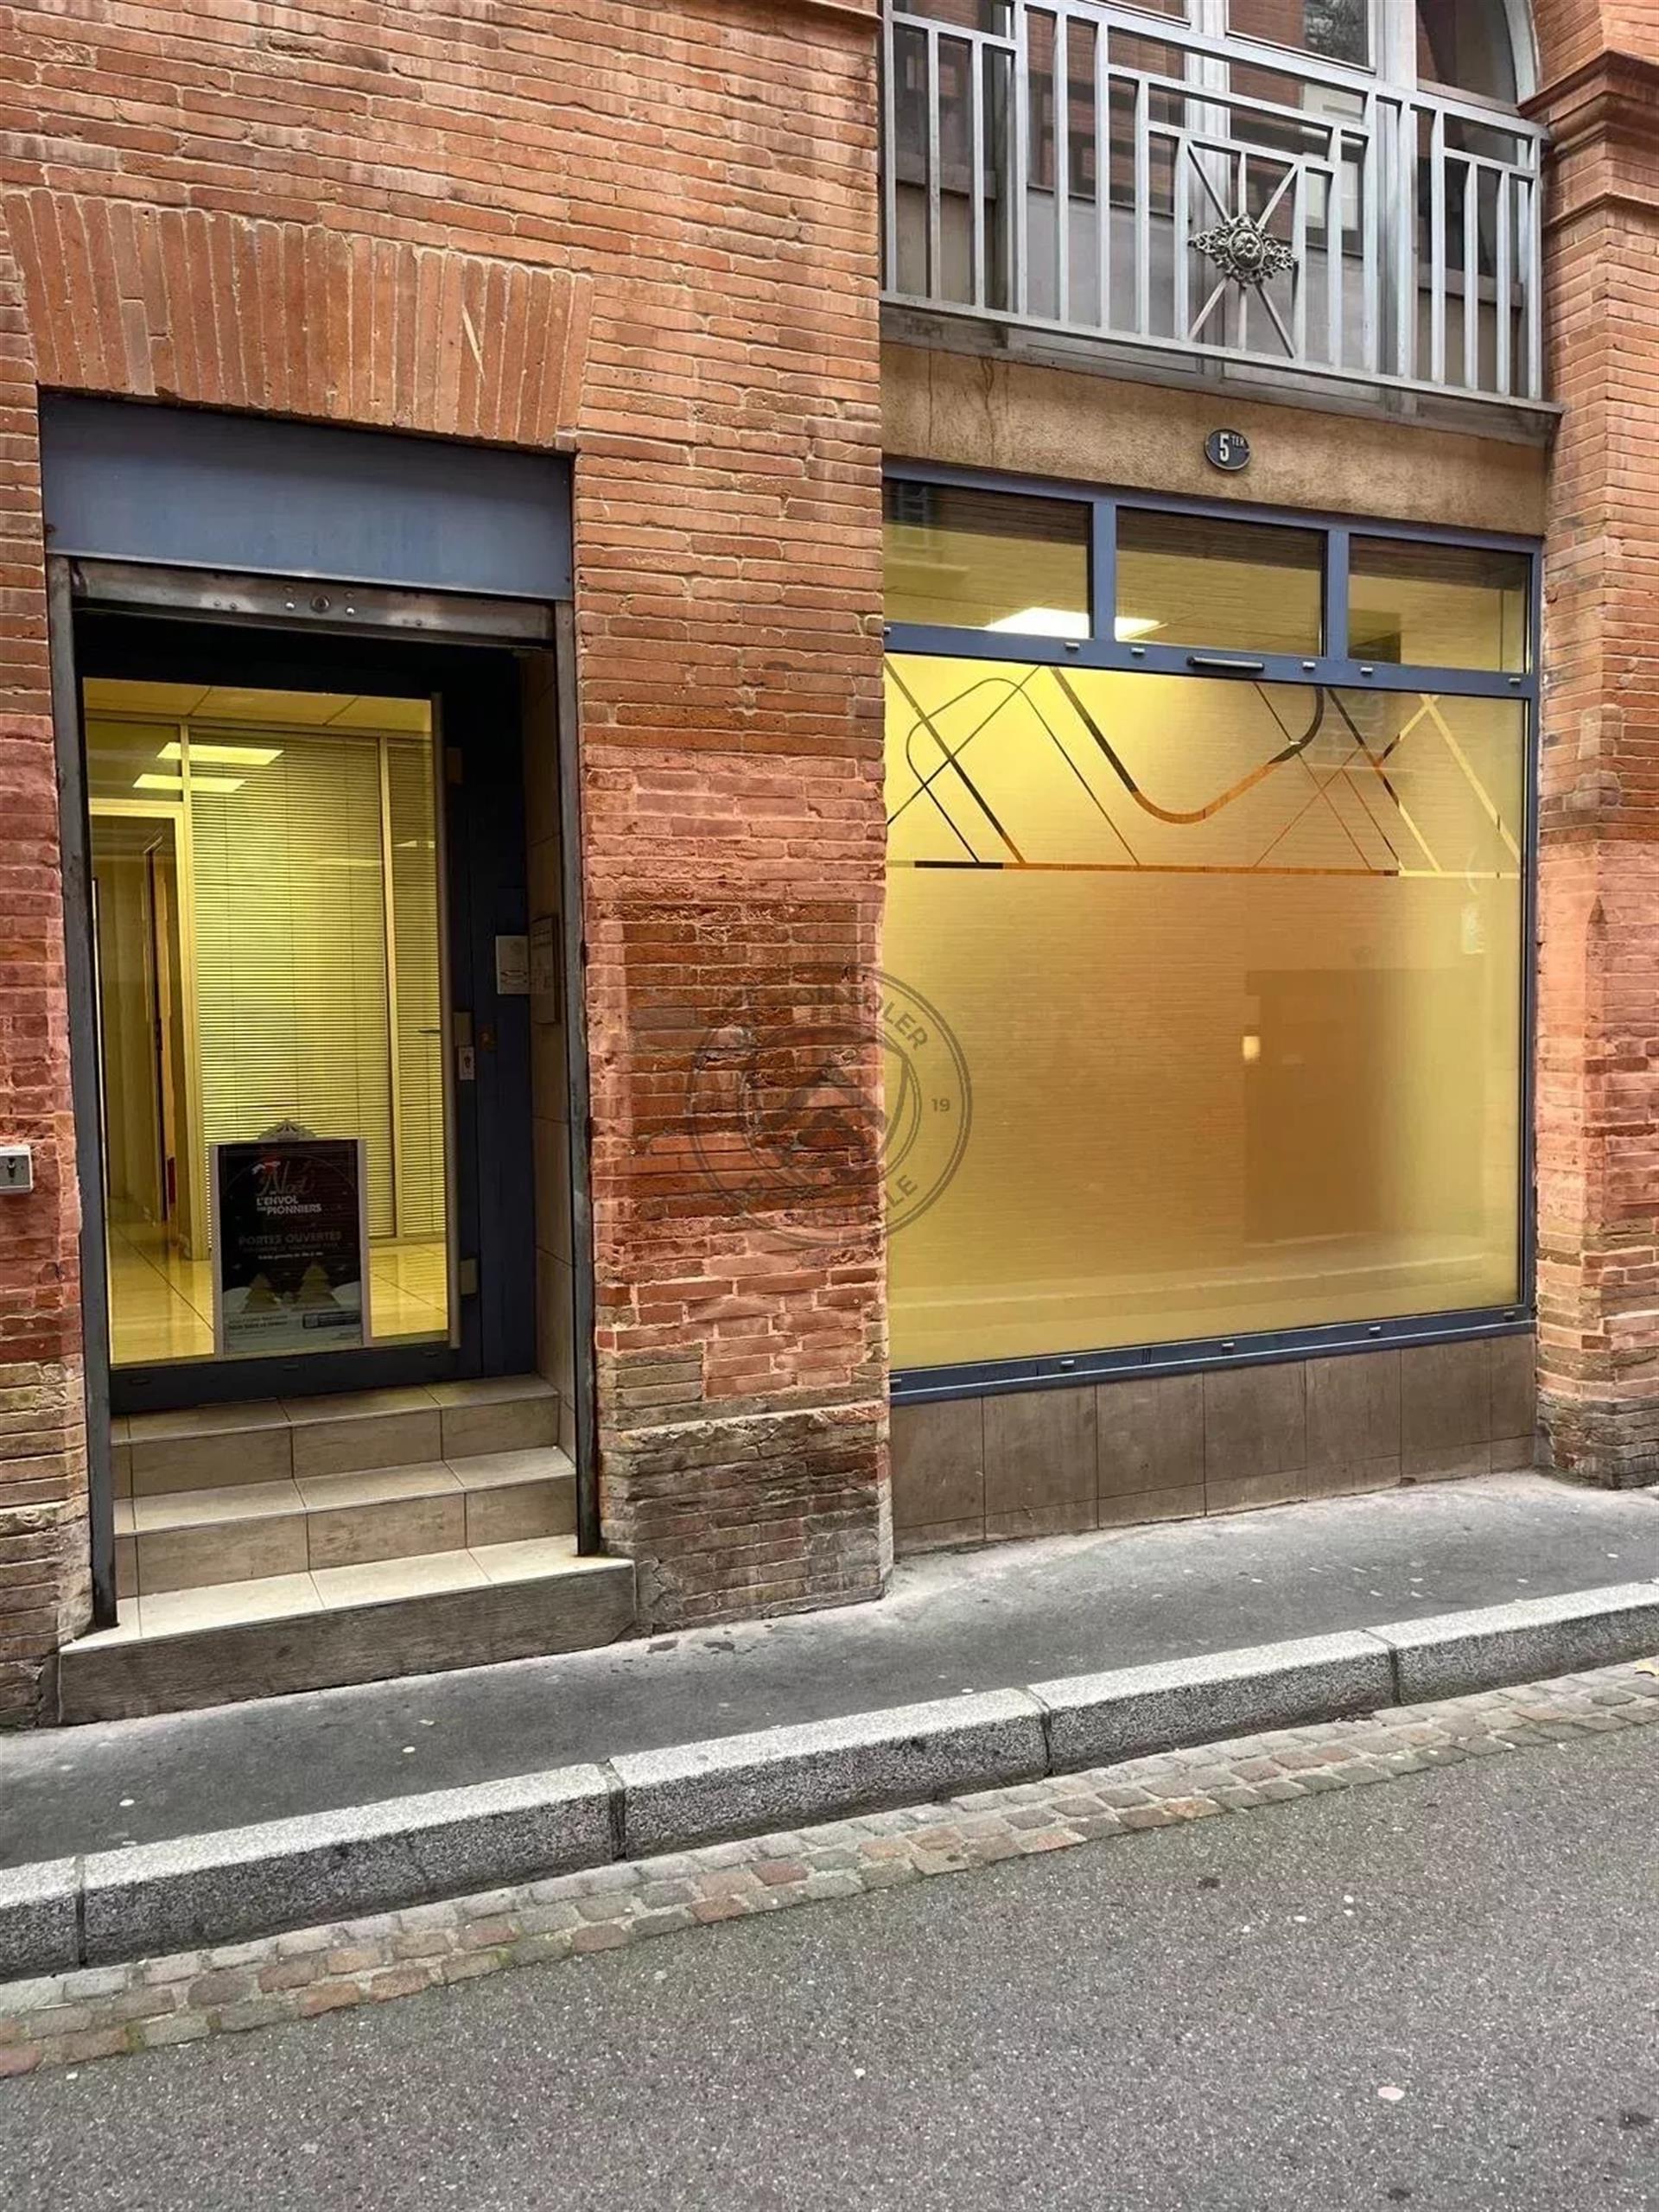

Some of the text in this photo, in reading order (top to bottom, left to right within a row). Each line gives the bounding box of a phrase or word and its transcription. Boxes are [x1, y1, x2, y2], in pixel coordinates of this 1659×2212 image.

[1219, 433, 1230, 462] 5
[256, 1194, 299, 1206] L'ENVOL
[266, 1204, 322, 1216] PIONNIERS
[238, 1230, 342, 1246] PORTES OUVERTES
